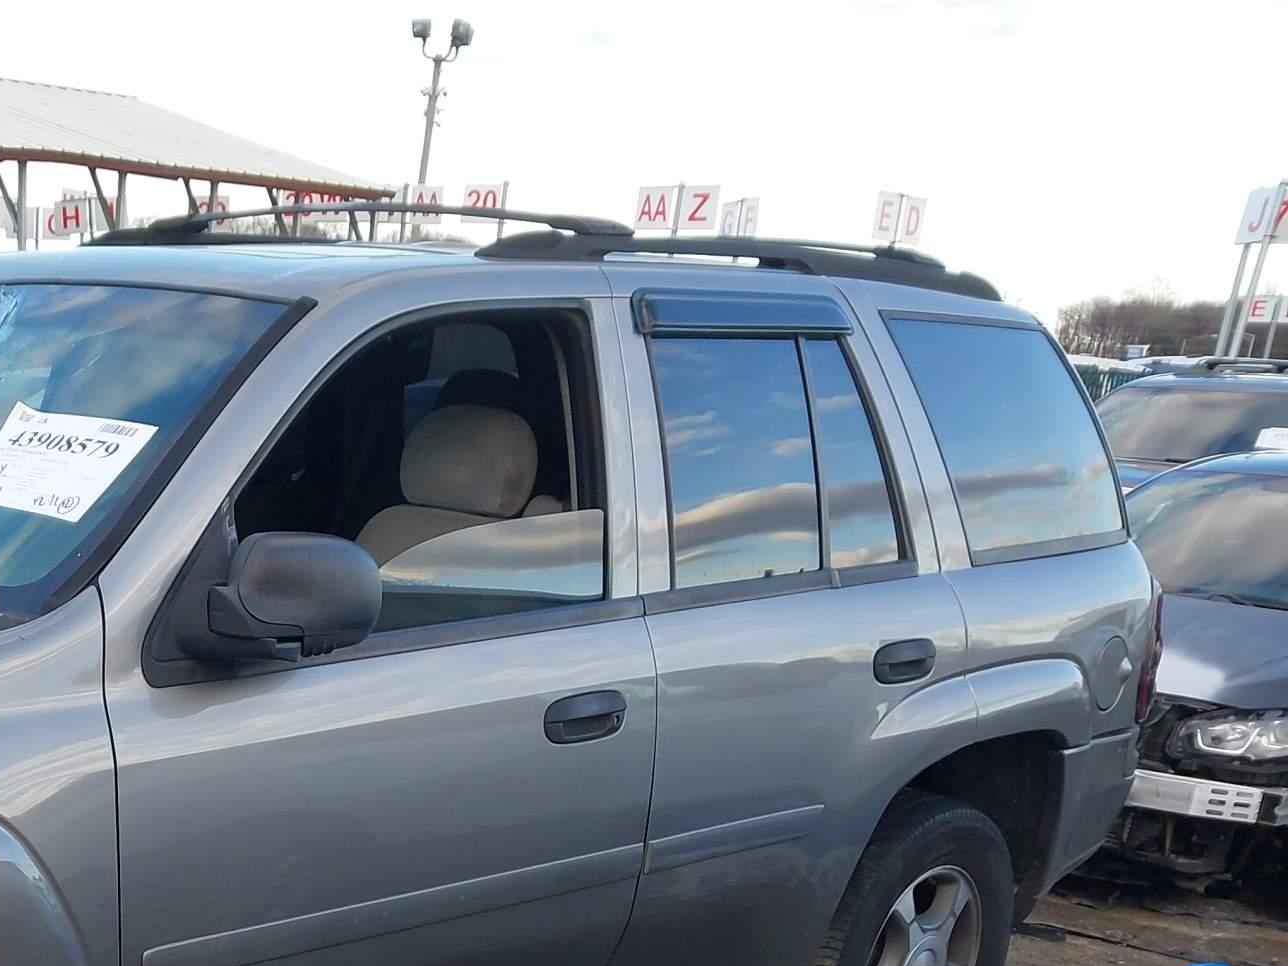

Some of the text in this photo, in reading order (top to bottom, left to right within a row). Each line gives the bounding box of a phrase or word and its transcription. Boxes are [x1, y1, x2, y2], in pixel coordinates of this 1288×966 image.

[62, 205, 80, 229] H
[638, 193, 667, 222] AA
[687, 192, 711, 222] Z
[878, 199, 894, 231] E
[905, 205, 920, 236] D
[1248, 196, 1270, 233] J
[1251, 300, 1267, 317] E
[8, 430, 121, 459] 43908579
